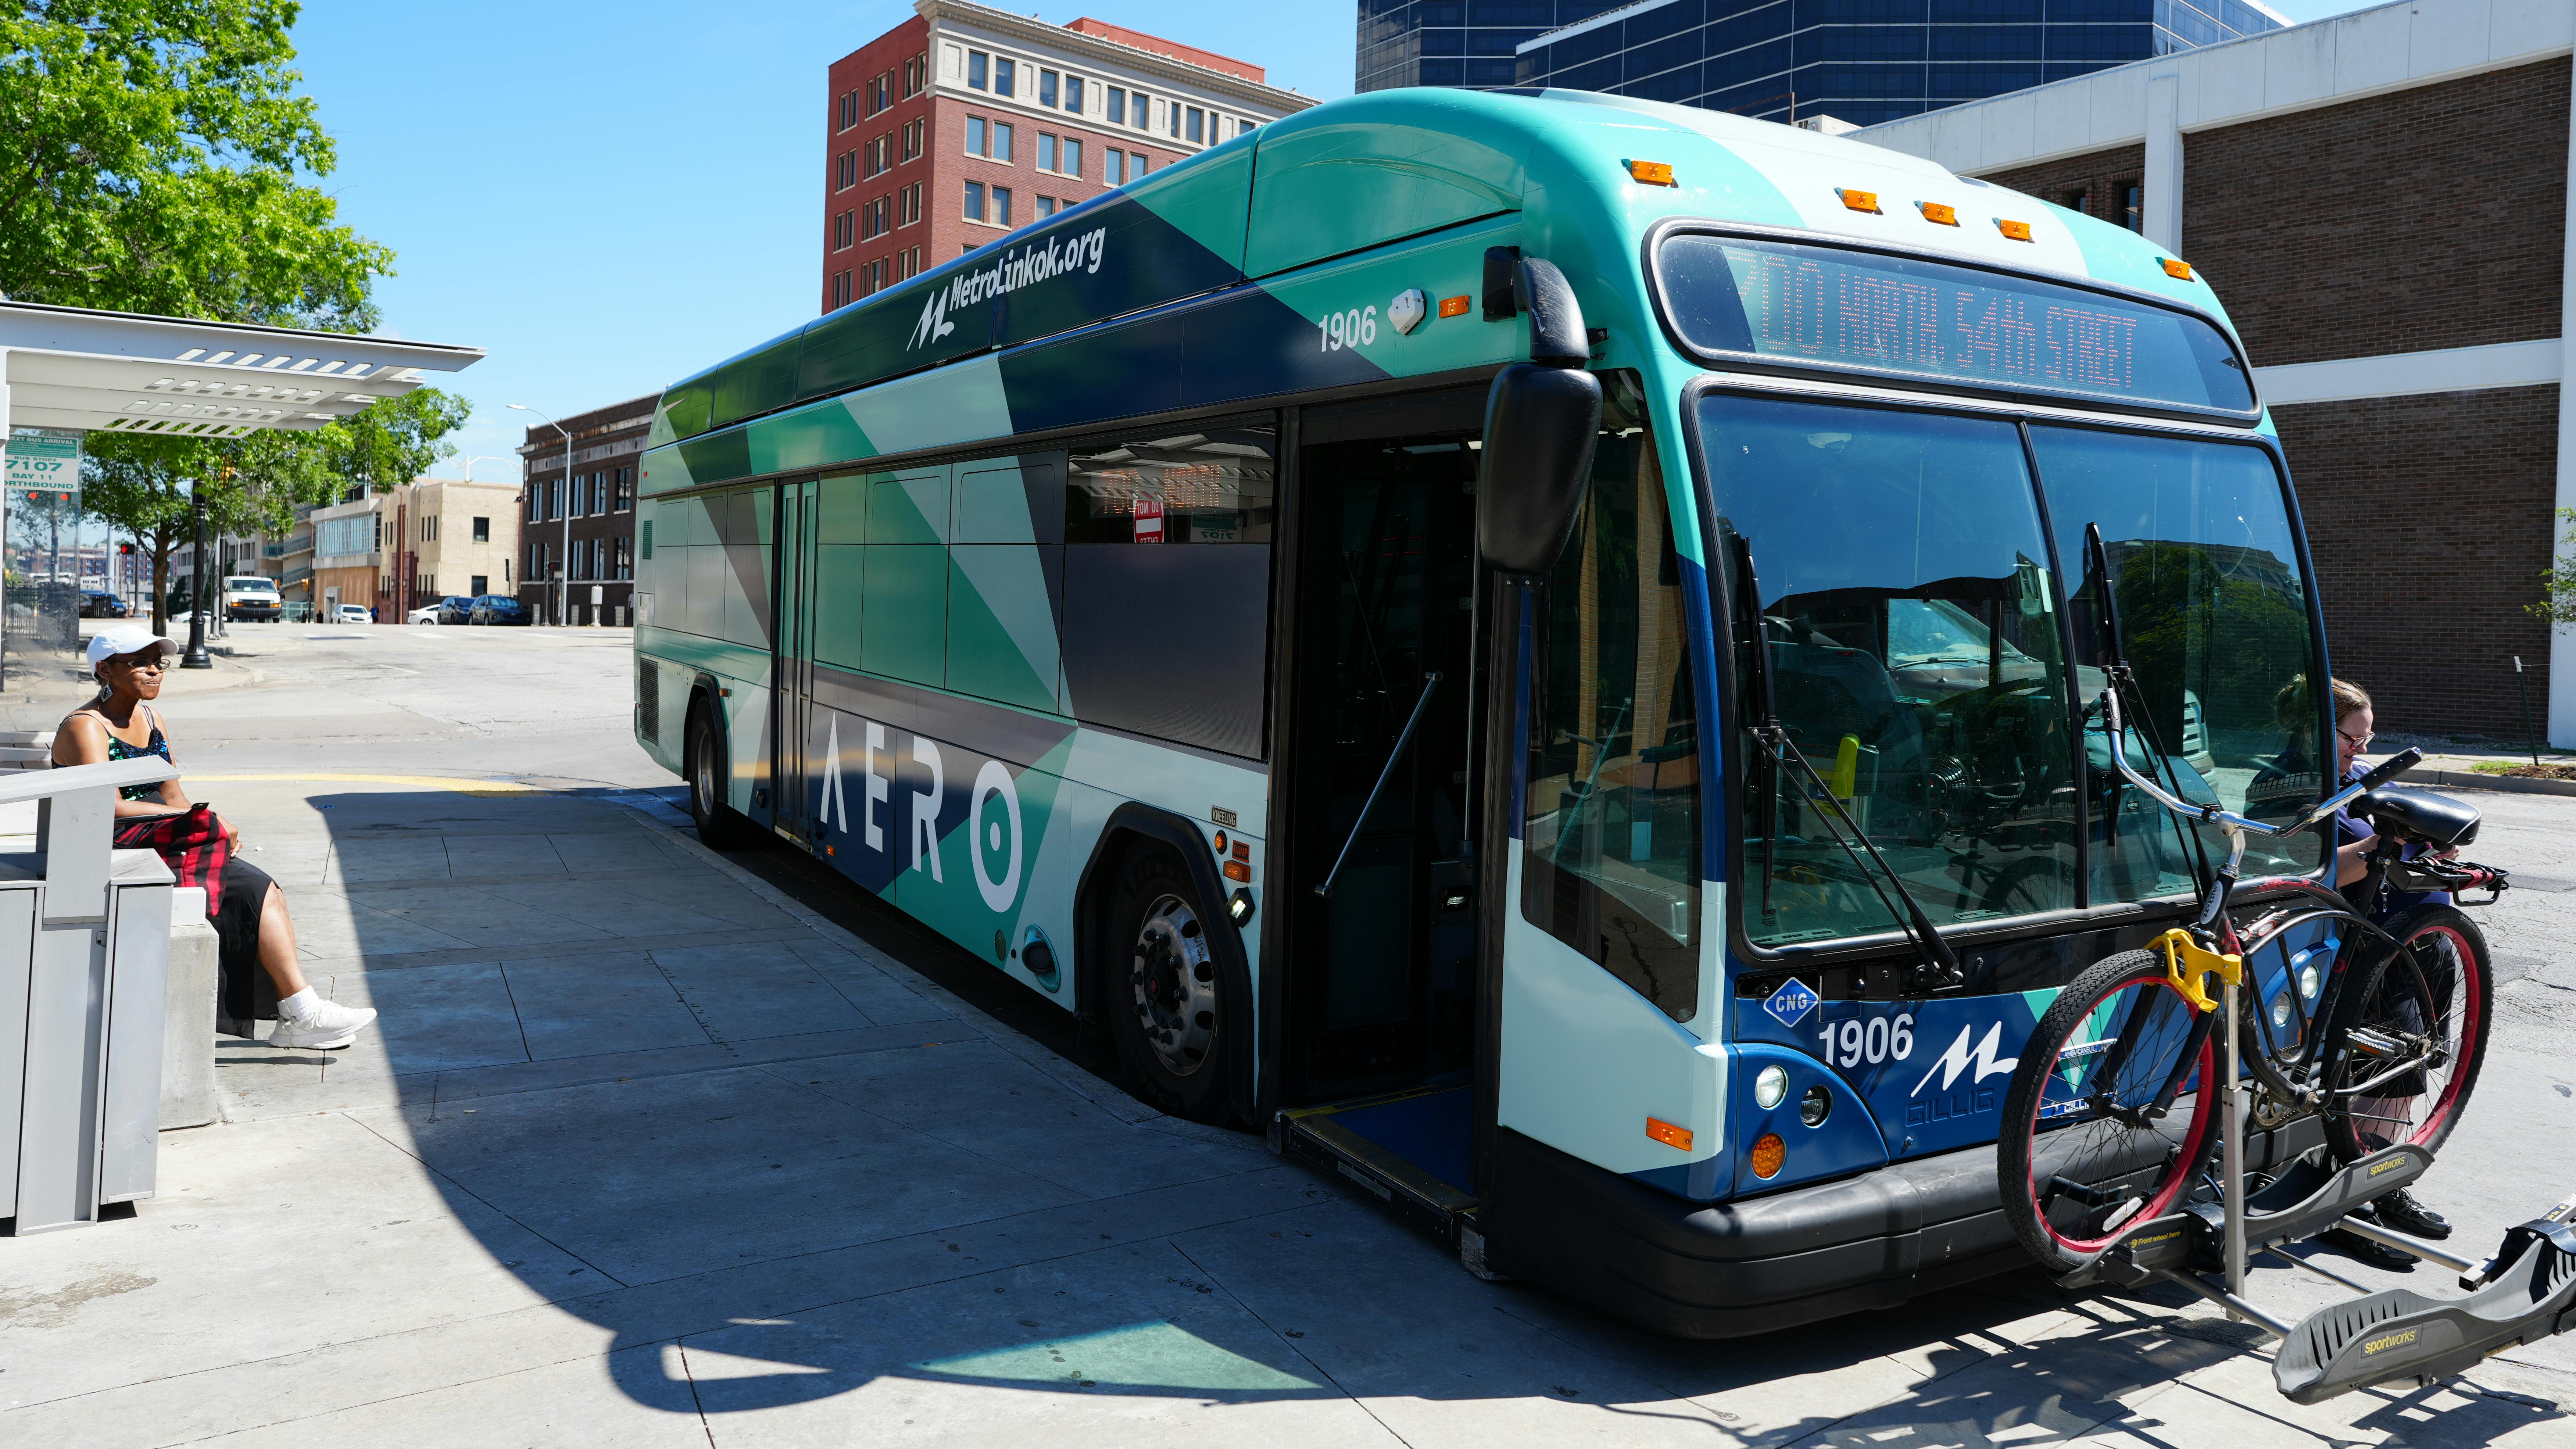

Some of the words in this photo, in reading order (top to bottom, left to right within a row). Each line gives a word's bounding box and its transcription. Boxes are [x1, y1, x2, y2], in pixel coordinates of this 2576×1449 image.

[949, 227, 1106, 311] MetroLinkok.org
[1319, 305, 1377, 352] 1906
[1729, 251, 1822, 355] 700
[2047, 307, 2137, 387] STREET
[5, 460, 62, 472] 7107
[820, 711, 1022, 913] AERO
[1213, 809, 1236, 826] KNEELING
[1234, 845, 1248, 858] RAMP
[2203, 887, 2218, 918] SCHWINN
[1775, 992, 1807, 1012] CNG
[1818, 1013, 1914, 1068] 1906
[1905, 1088, 1994, 1127] GILLIG
[2064, 1101, 2089, 1113] GILLI
[2370, 1156, 2405, 1176] sportworks
[2138, 1237, 2153, 1245] Front
[2153, 1232, 2168, 1241] wheel
[2365, 1330, 2415, 1355] sportworks
